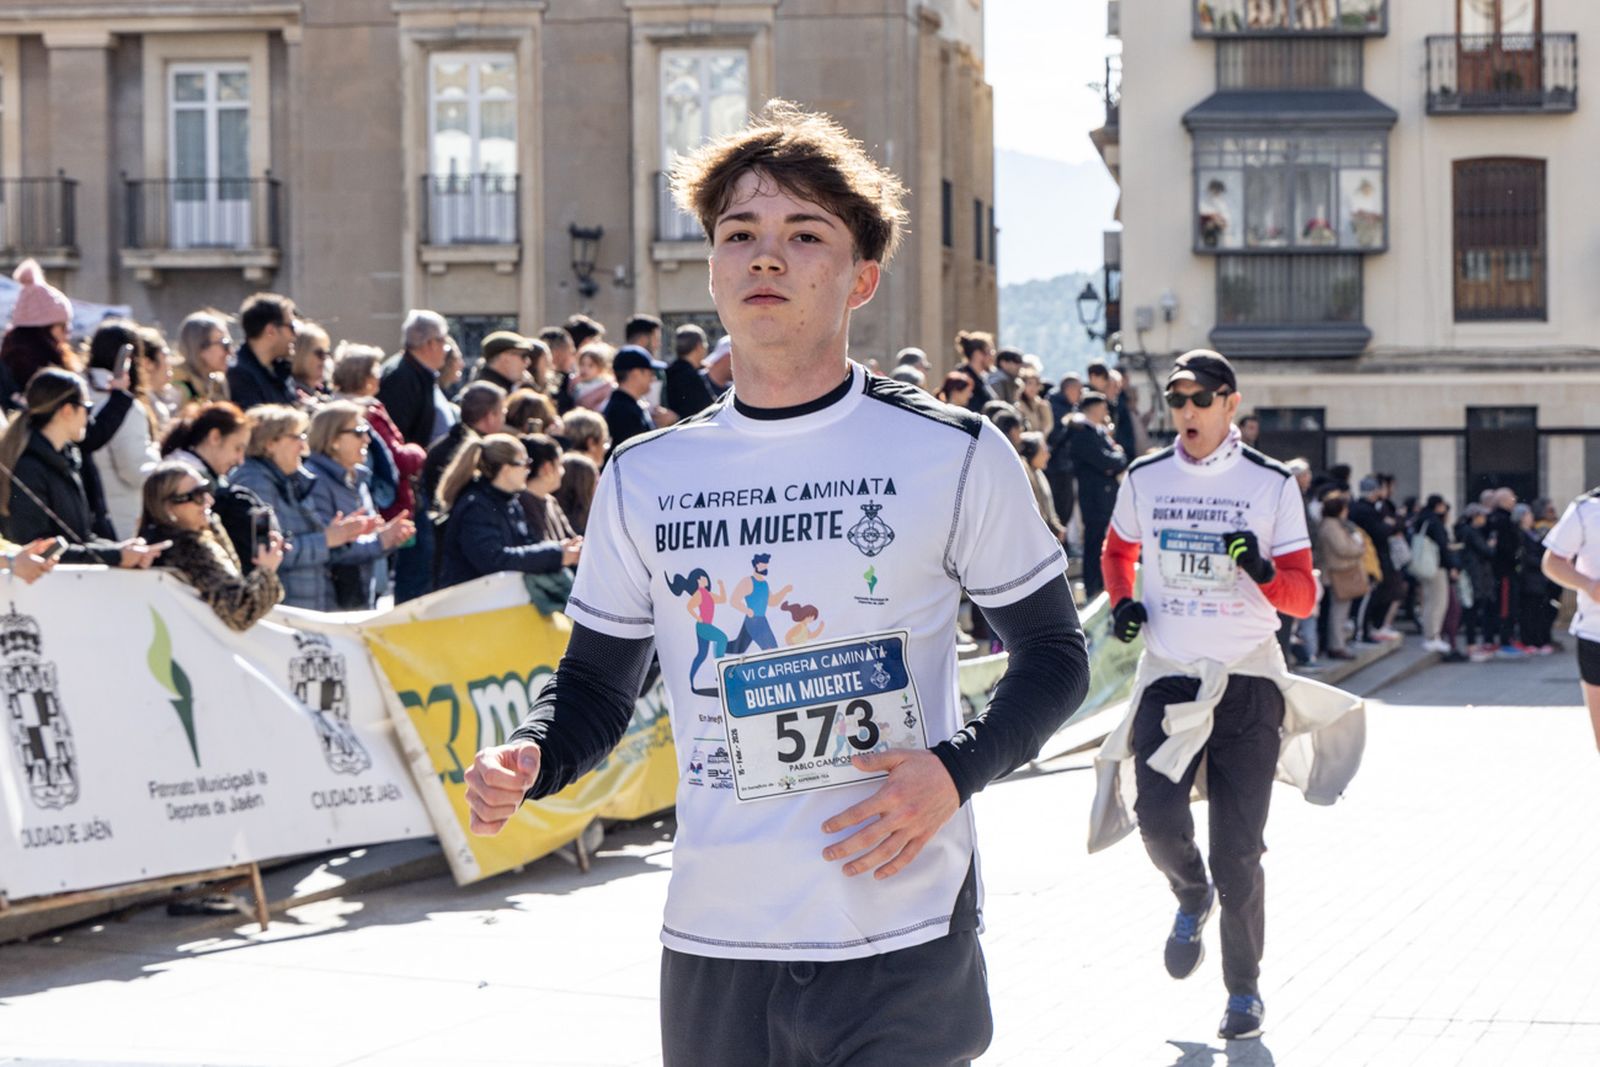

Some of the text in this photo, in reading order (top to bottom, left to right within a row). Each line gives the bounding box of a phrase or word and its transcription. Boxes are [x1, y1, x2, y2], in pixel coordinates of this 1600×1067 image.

[658, 477, 897, 511] VI CARRERA CAMINATA
[1153, 507, 1228, 522] BUENA MUERTE
[655, 509, 843, 553] BUENA MUERTE
[1180, 553, 1210, 574] 114
[742, 645, 887, 682] VI CARRERA CAMINATA
[744, 670, 863, 710] BUENA MUERTE
[777, 699, 880, 764] 573
[789, 755, 852, 772] PABLO CAMPOS
[197, 769, 255, 793] Municipal
[311, 787, 358, 810] CIUDAD
[166, 802, 211, 822] Deportes
